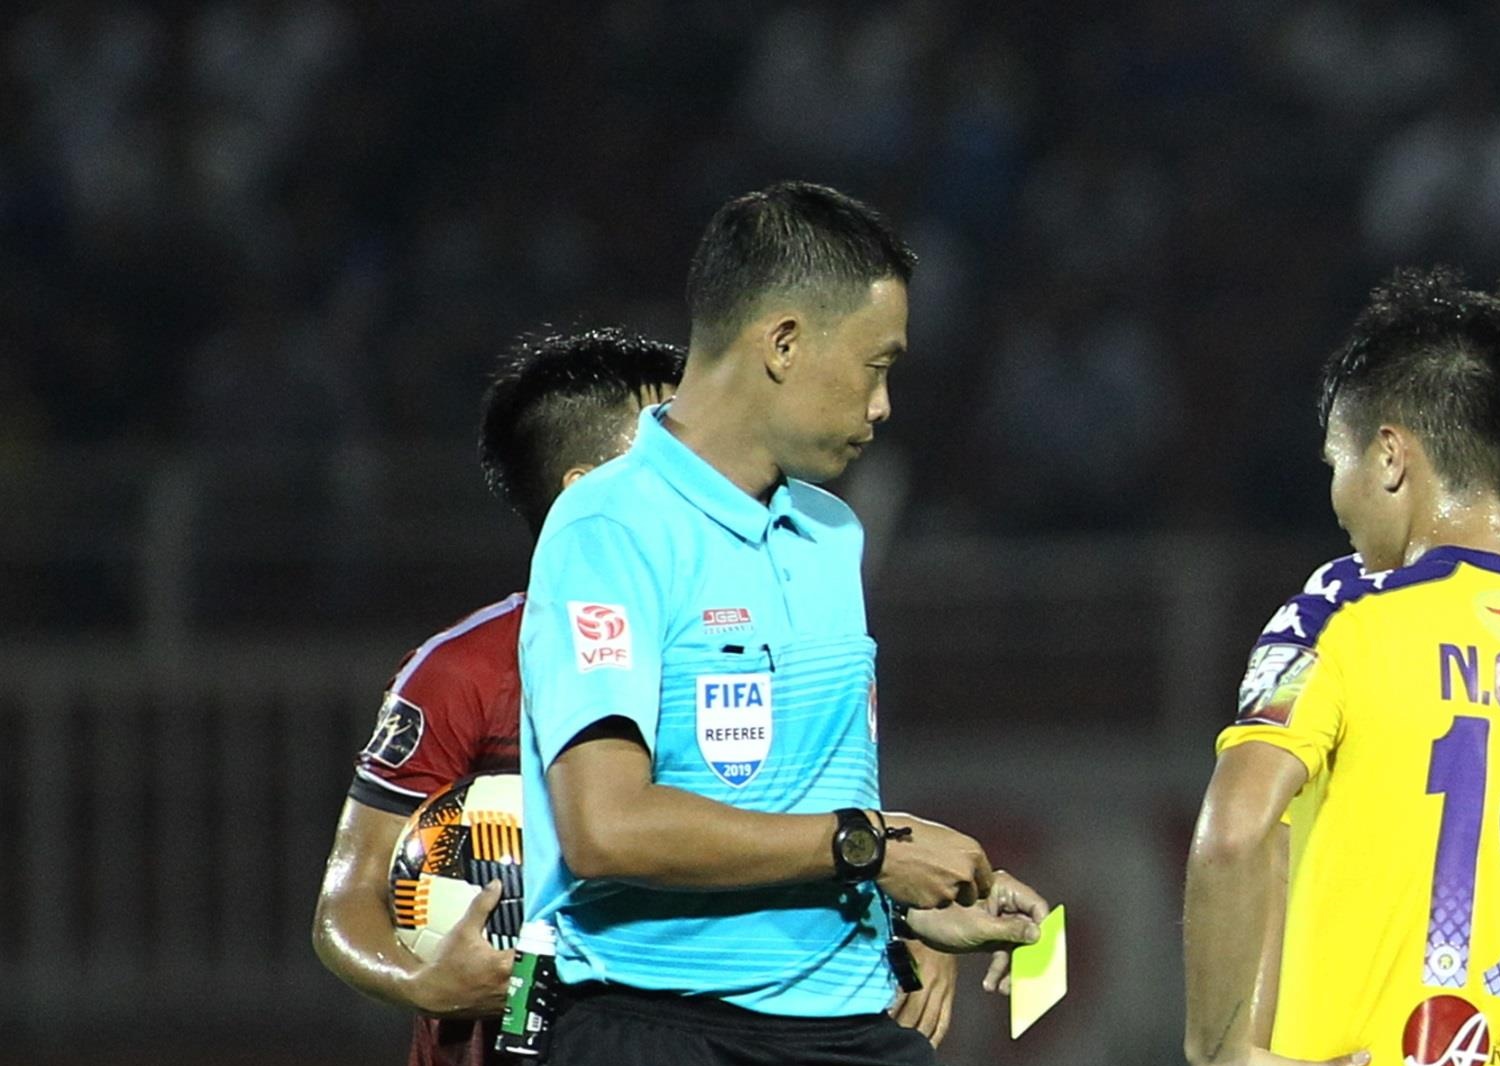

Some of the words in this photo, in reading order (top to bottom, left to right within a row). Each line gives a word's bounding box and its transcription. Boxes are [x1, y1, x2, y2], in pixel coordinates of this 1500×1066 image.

[581, 647, 628, 665] VPF
[705, 682, 763, 709] FIFA
[705, 727, 765, 742] REFEREE
[723, 763, 752, 778] 2019
